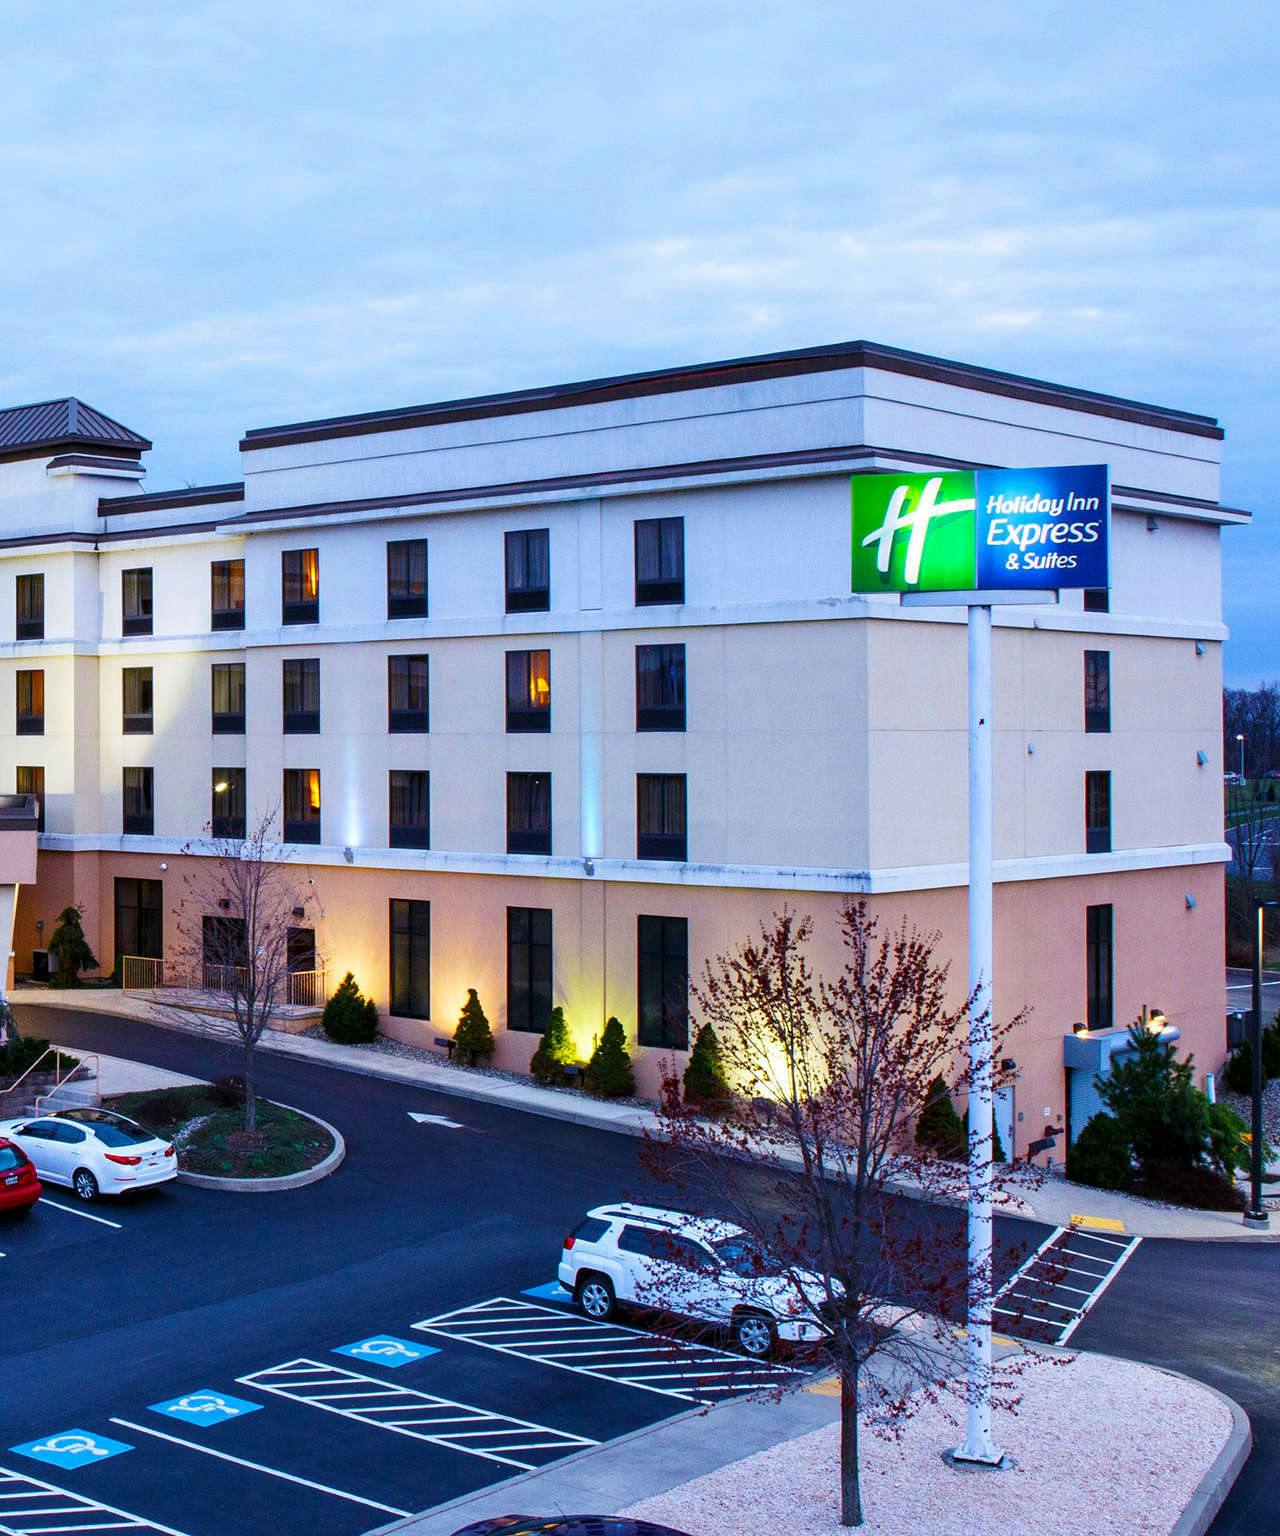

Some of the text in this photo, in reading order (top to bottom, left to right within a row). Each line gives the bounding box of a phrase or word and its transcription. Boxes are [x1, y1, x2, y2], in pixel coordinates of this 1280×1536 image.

[986, 491, 1099, 517] Holiday Inn
[986, 518, 1099, 551] Express
[1005, 552, 1078, 570] & Suites
